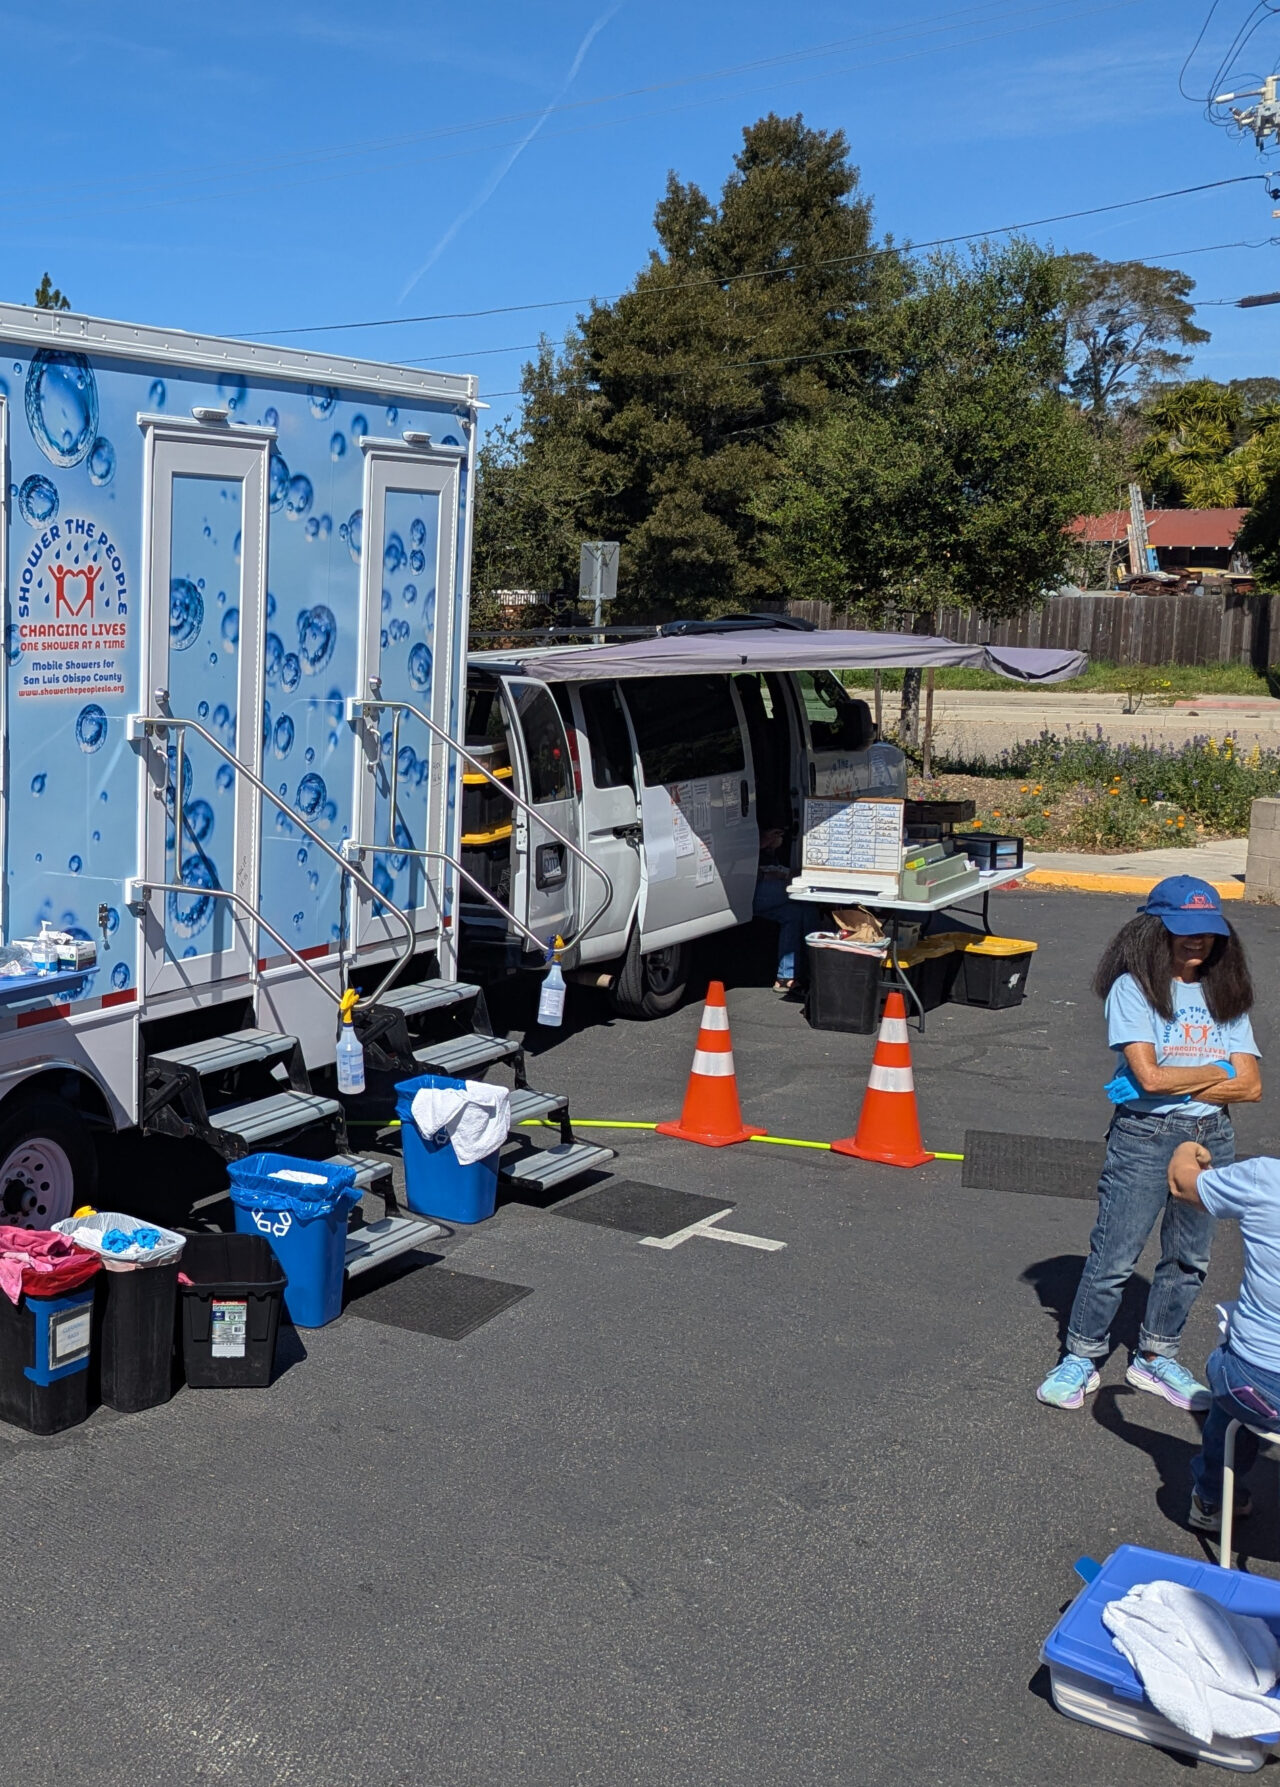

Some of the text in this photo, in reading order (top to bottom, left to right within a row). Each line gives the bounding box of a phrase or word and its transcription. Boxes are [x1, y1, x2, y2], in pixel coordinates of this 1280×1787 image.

[18, 518, 128, 618] SHOWER THE PEOPLE
[19, 623, 126, 638] CHANGING LIVES
[20, 639, 126, 652] ONE SHOWER AT A TIME
[32, 659, 115, 672] Mobile Showers for
[23, 672, 123, 685] San Luis Obispo County
[18, 684, 126, 697] www.showerthepeopleslo.org
[1189, 1006, 1208, 1016] THE
